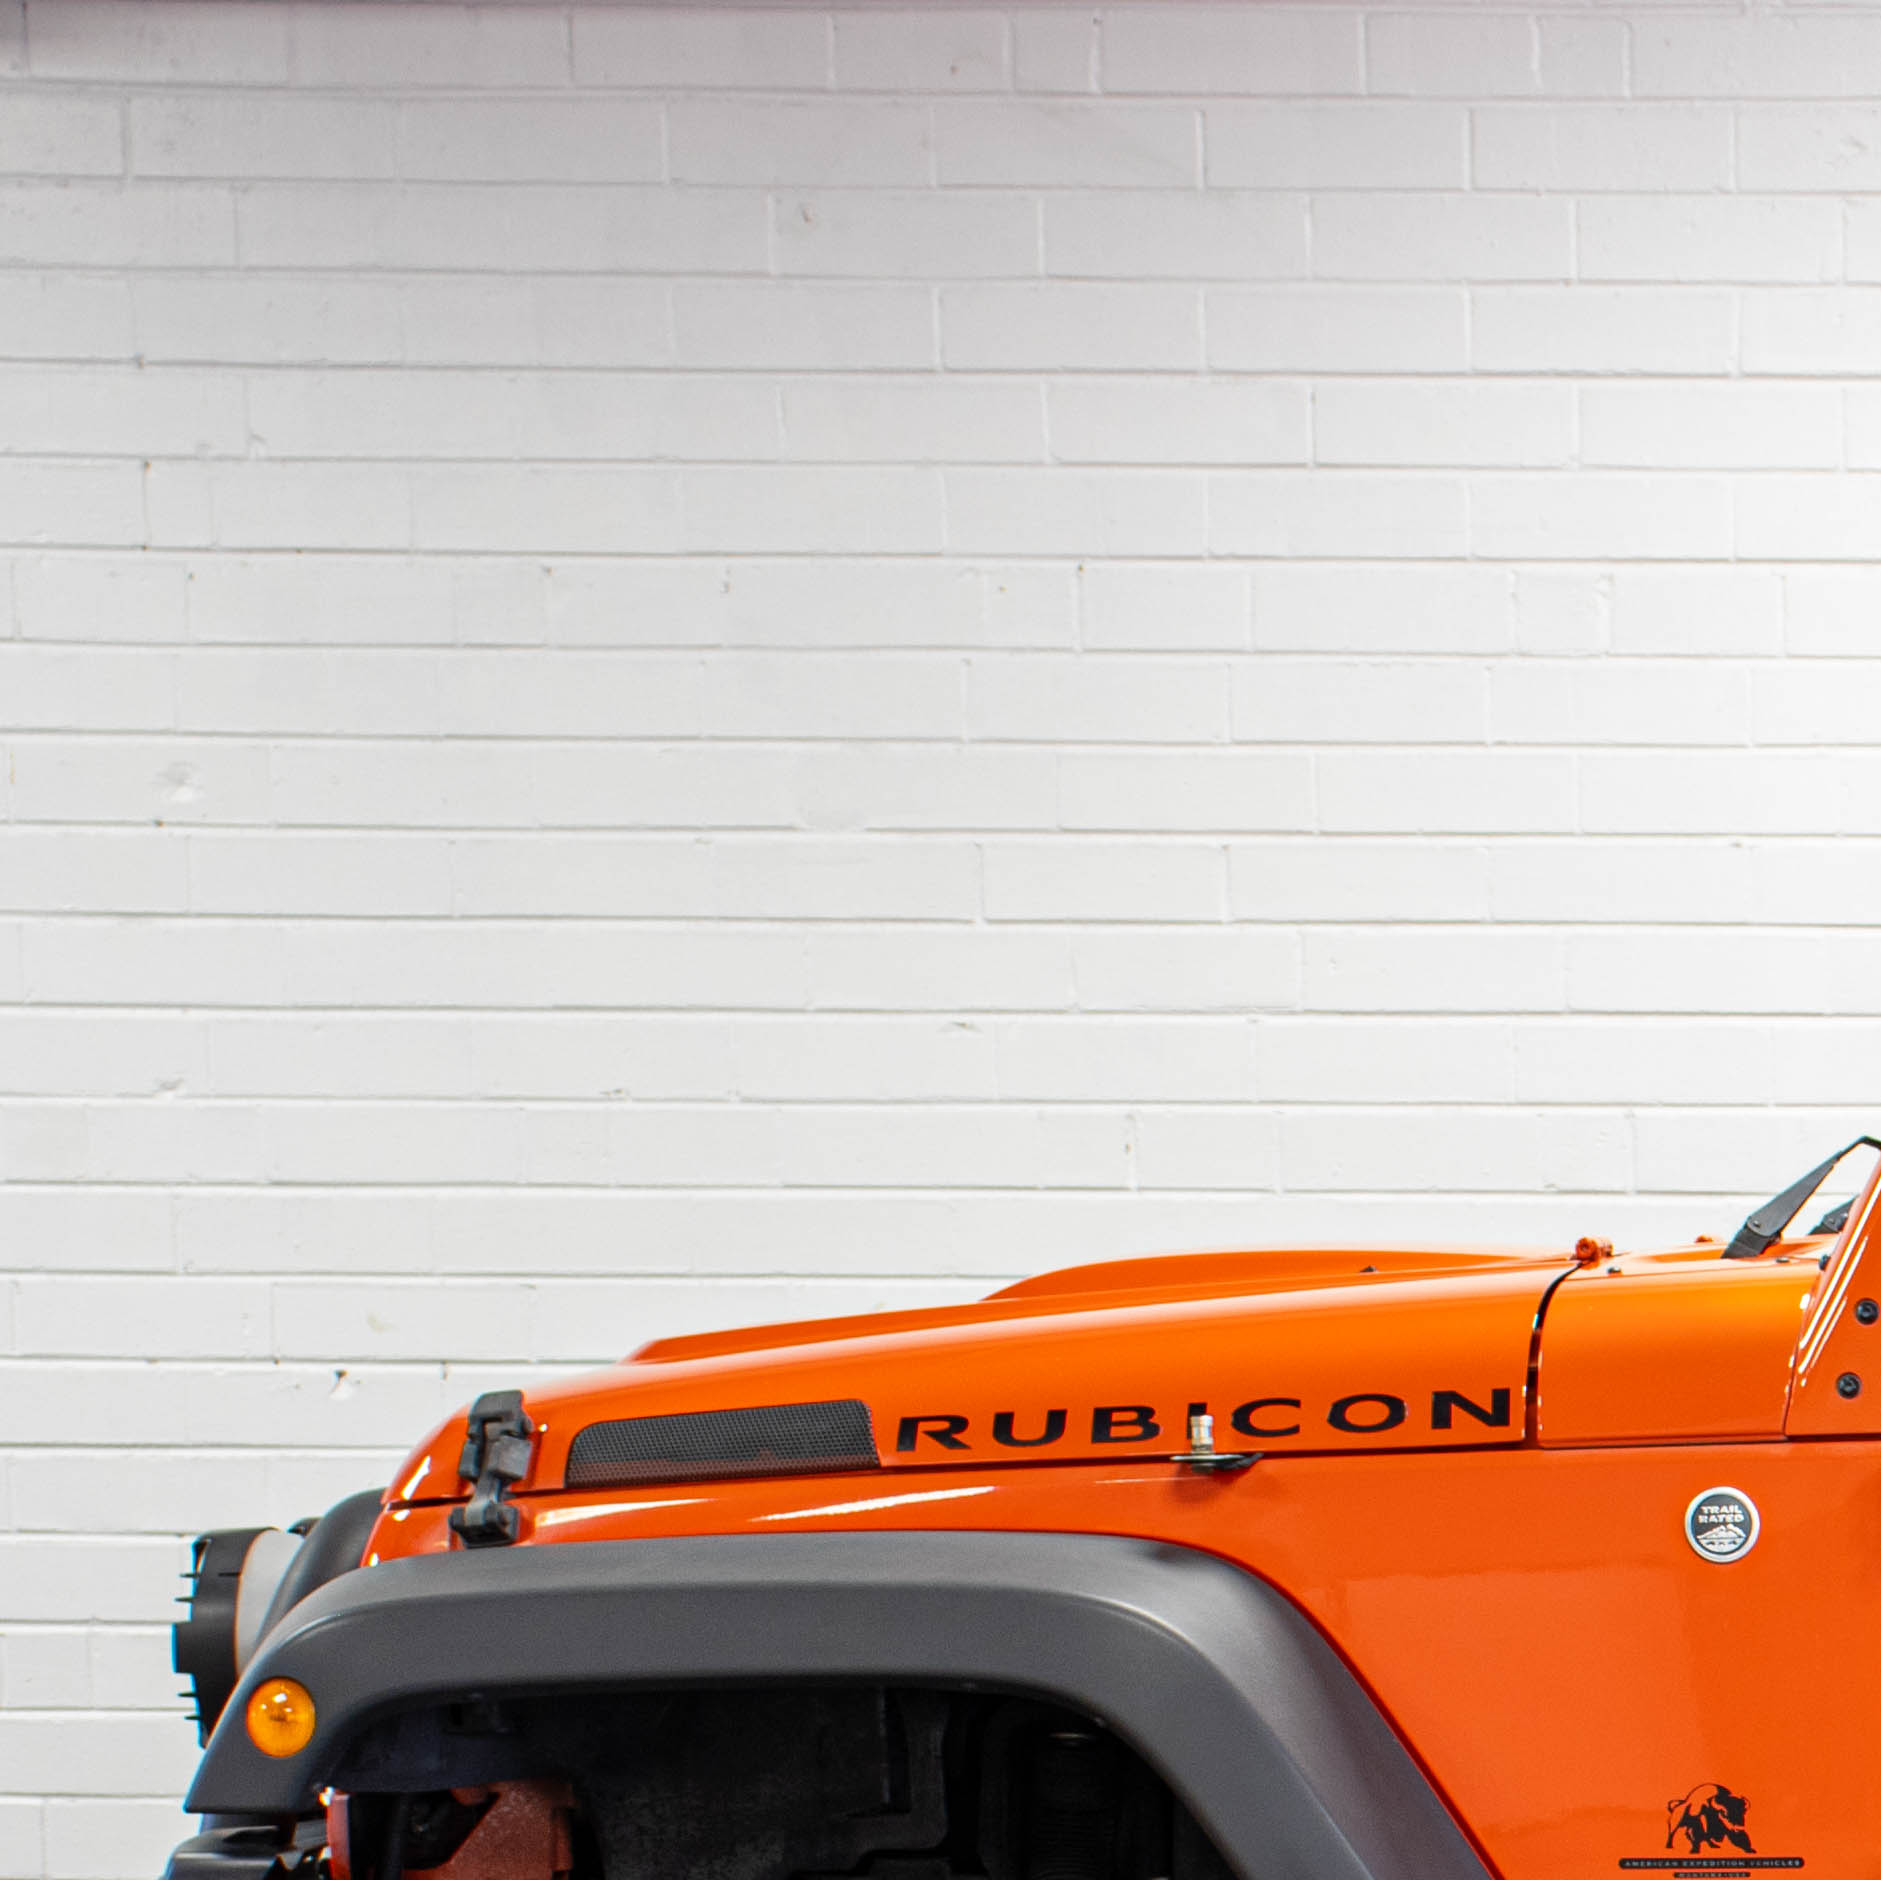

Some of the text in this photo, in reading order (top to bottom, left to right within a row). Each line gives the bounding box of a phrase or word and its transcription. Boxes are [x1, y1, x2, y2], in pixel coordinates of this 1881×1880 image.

[897, 1387, 1511, 1452] RUBICON
[1701, 1503, 1743, 1514] TRAIL
[1698, 1513, 1745, 1524] RATED
